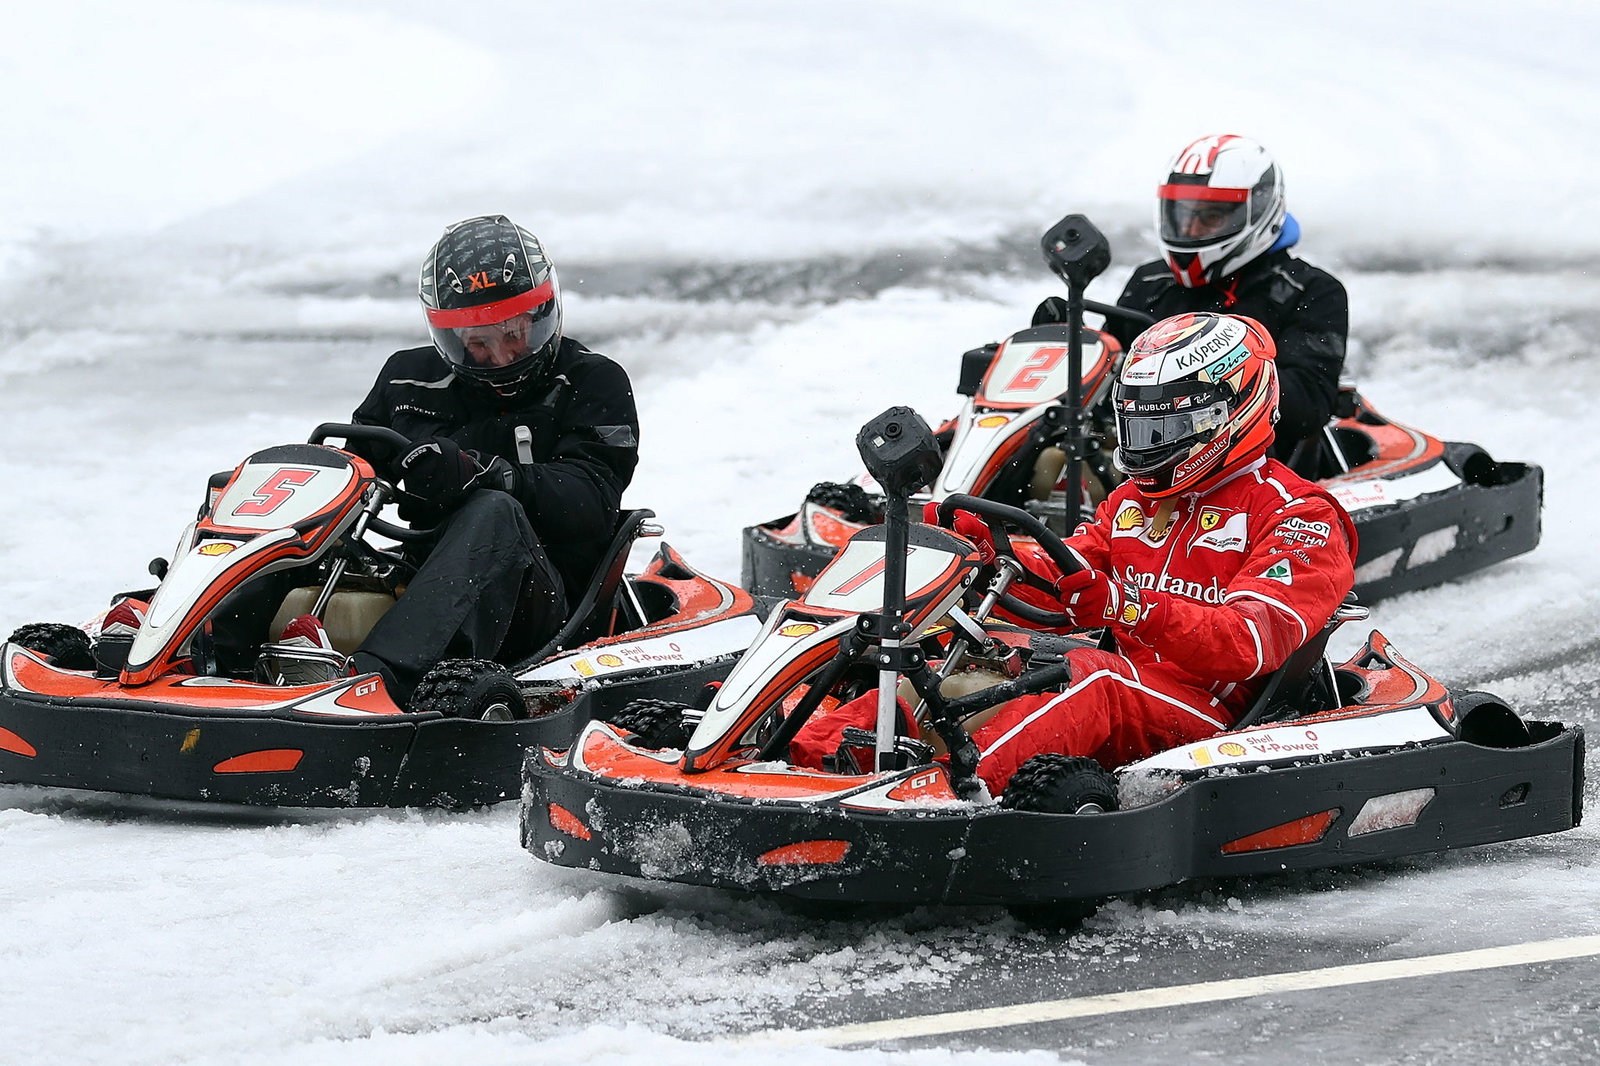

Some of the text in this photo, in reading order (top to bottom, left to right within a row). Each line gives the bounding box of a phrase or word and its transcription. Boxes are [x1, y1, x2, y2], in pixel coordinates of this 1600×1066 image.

[467, 271, 497, 292] XL
[1175, 325, 1235, 370] KASPERSKY
[1001, 346, 1069, 393] 2
[1210, 350, 1249, 379] Riva
[394, 404, 436, 416] AIR-VENT
[1138, 403, 1171, 412] HUBLOT
[1183, 437, 1228, 473] Santander
[231, 467, 321, 517] 5
[1274, 529, 1327, 548] WEICHAI
[1126, 565, 1228, 605] Santande
[620, 646, 644, 656] Shell
[628, 652, 685, 664] V-Power
[355, 680, 379, 697] GT
[1246, 734, 1274, 745] Shell
[1253, 742, 1319, 753] V-Power
[911, 770, 940, 790] GT
